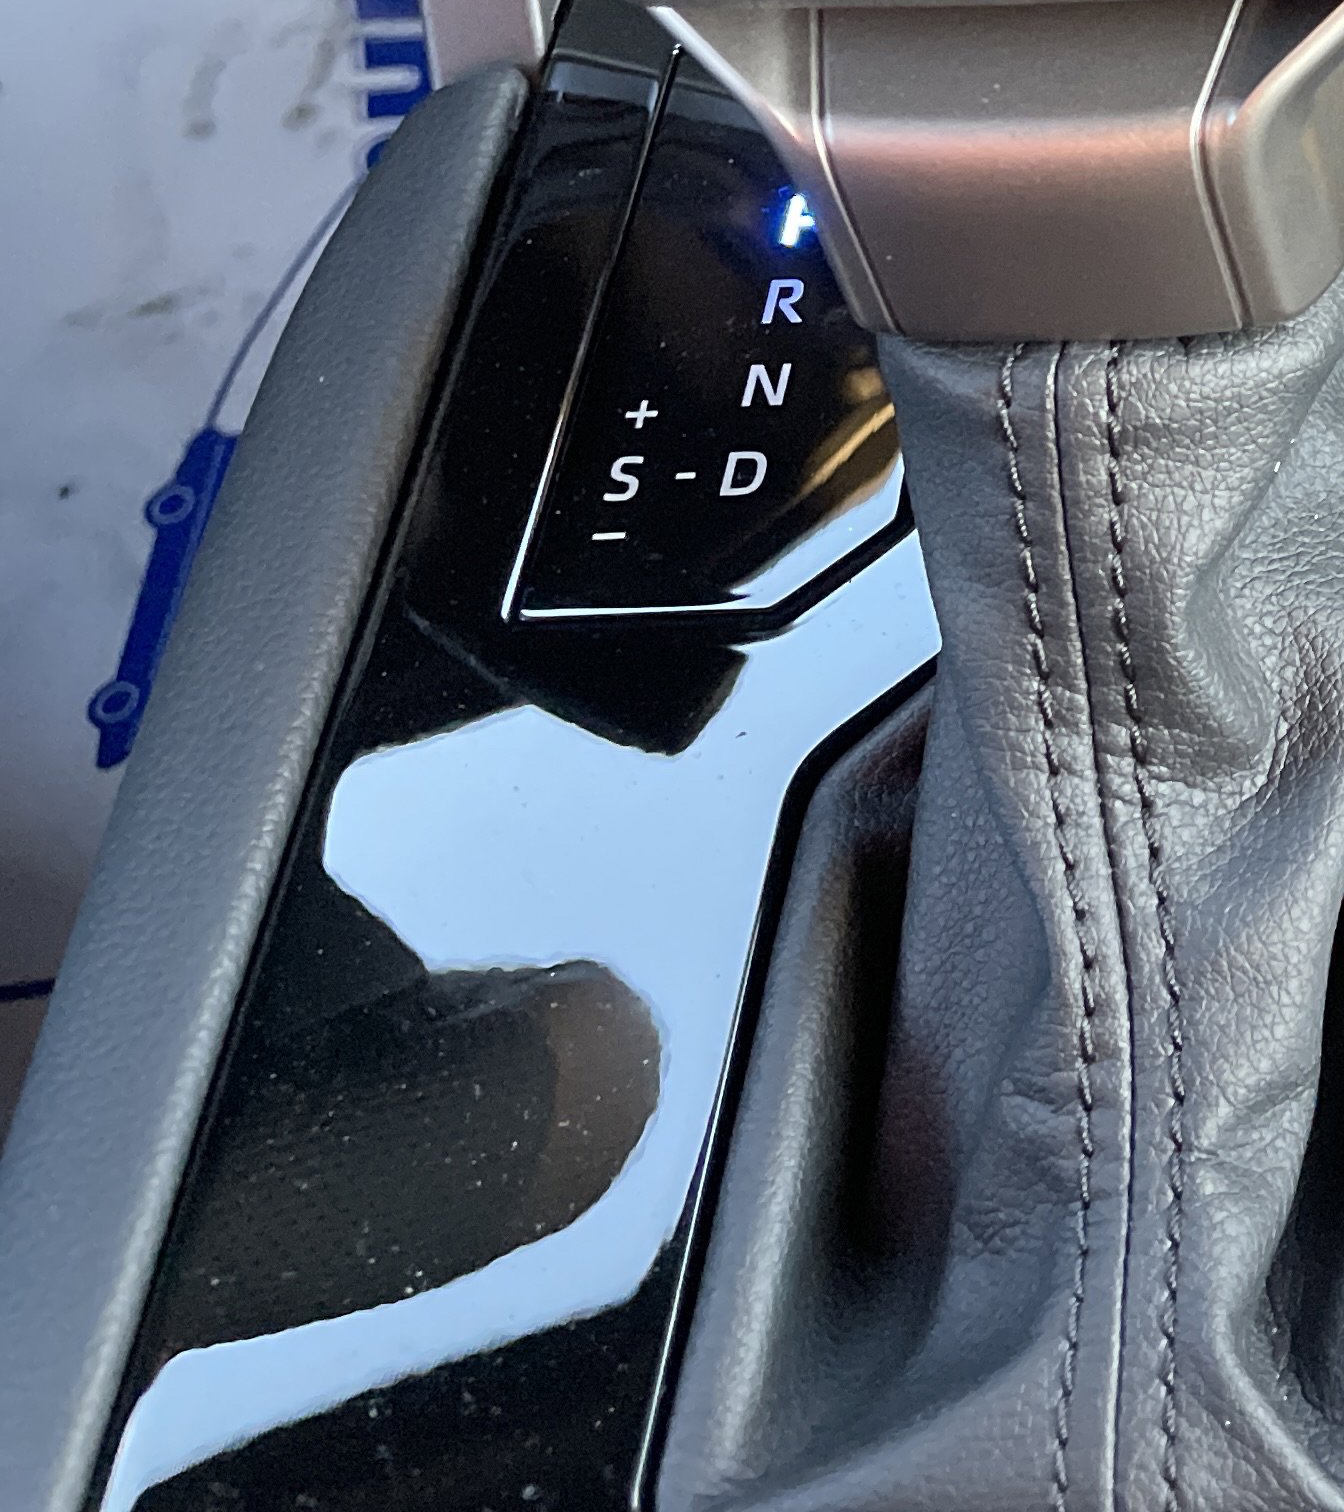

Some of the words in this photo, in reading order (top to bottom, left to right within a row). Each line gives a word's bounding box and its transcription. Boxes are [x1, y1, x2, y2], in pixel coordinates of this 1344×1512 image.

[760, 278, 805, 325] R
[740, 363, 792, 408] N
[602, 455, 645, 502] S
[719, 450, 768, 497] D
